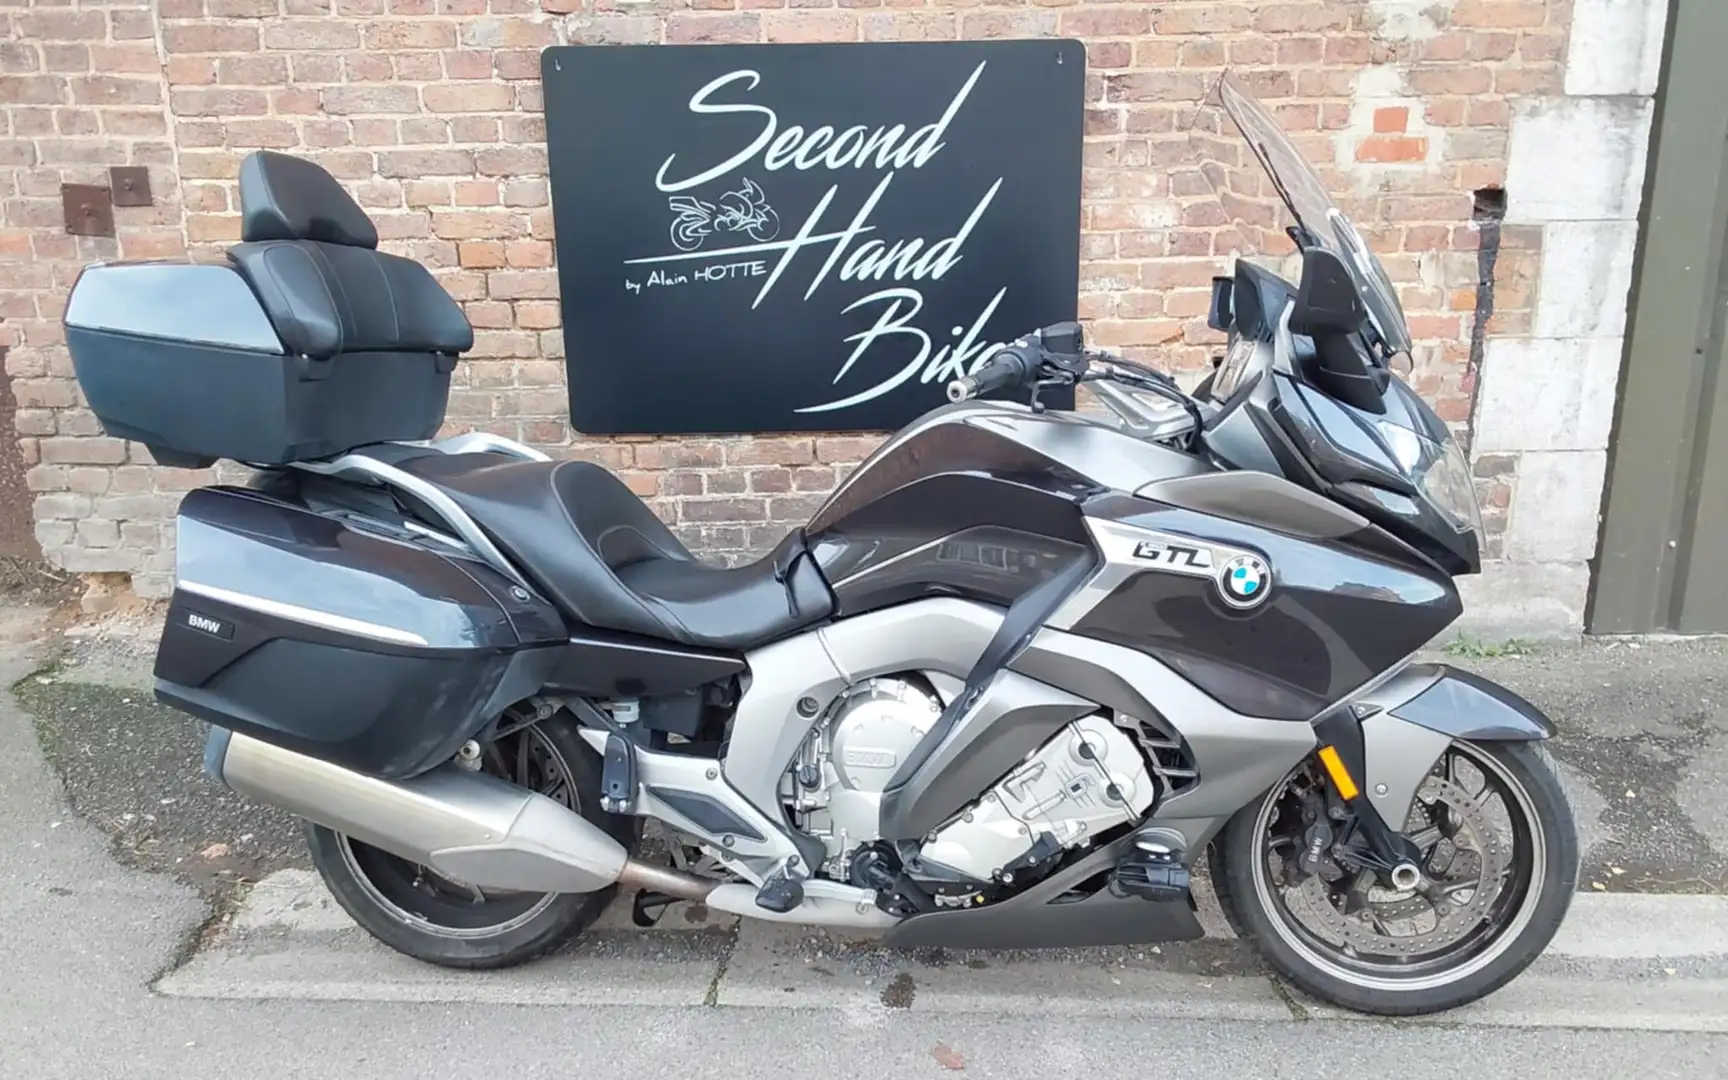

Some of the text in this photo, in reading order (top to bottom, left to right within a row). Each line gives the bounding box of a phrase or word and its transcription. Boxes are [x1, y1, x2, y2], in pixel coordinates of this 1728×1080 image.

[655, 60, 987, 192] Second
[624, 172, 1003, 310] Hand
[625, 260, 767, 295] by Alain HOTTE
[1132, 541, 1210, 568] GTL
[188, 614, 220, 633] BMW
[1308, 836, 1323, 863] BMW
